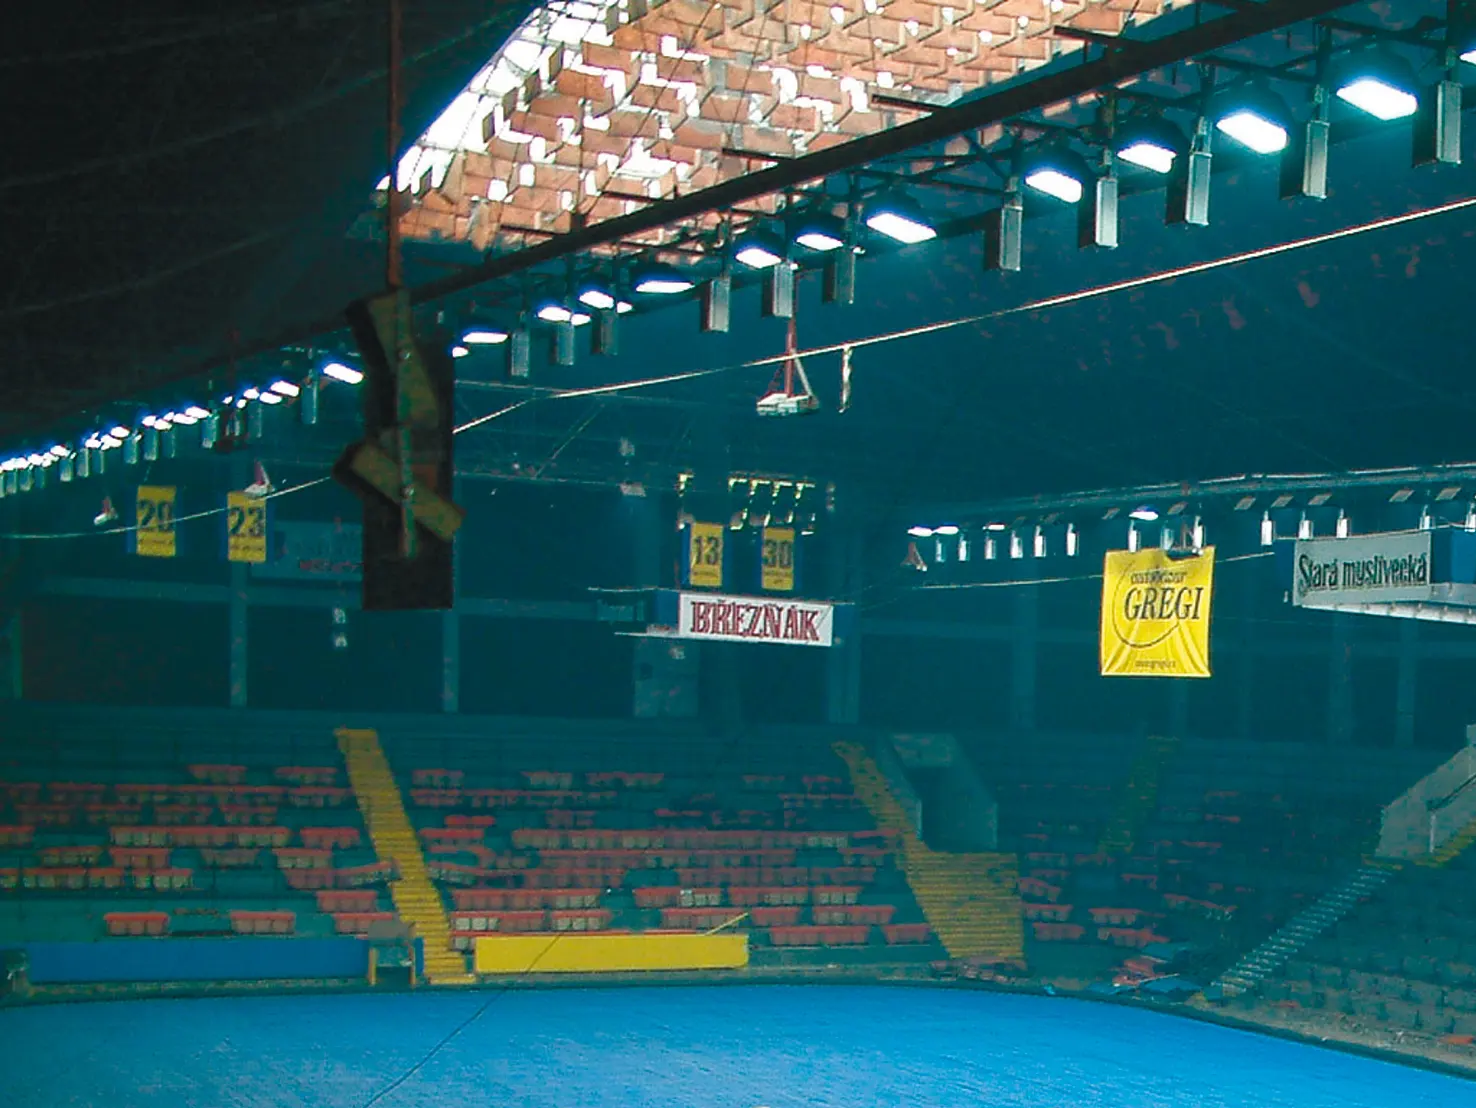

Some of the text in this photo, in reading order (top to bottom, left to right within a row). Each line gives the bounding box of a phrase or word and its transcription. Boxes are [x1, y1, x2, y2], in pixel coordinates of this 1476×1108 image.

[694, 536, 721, 565] 13
[763, 540, 793, 569] 30
[1124, 586, 1204, 620] GREGI
